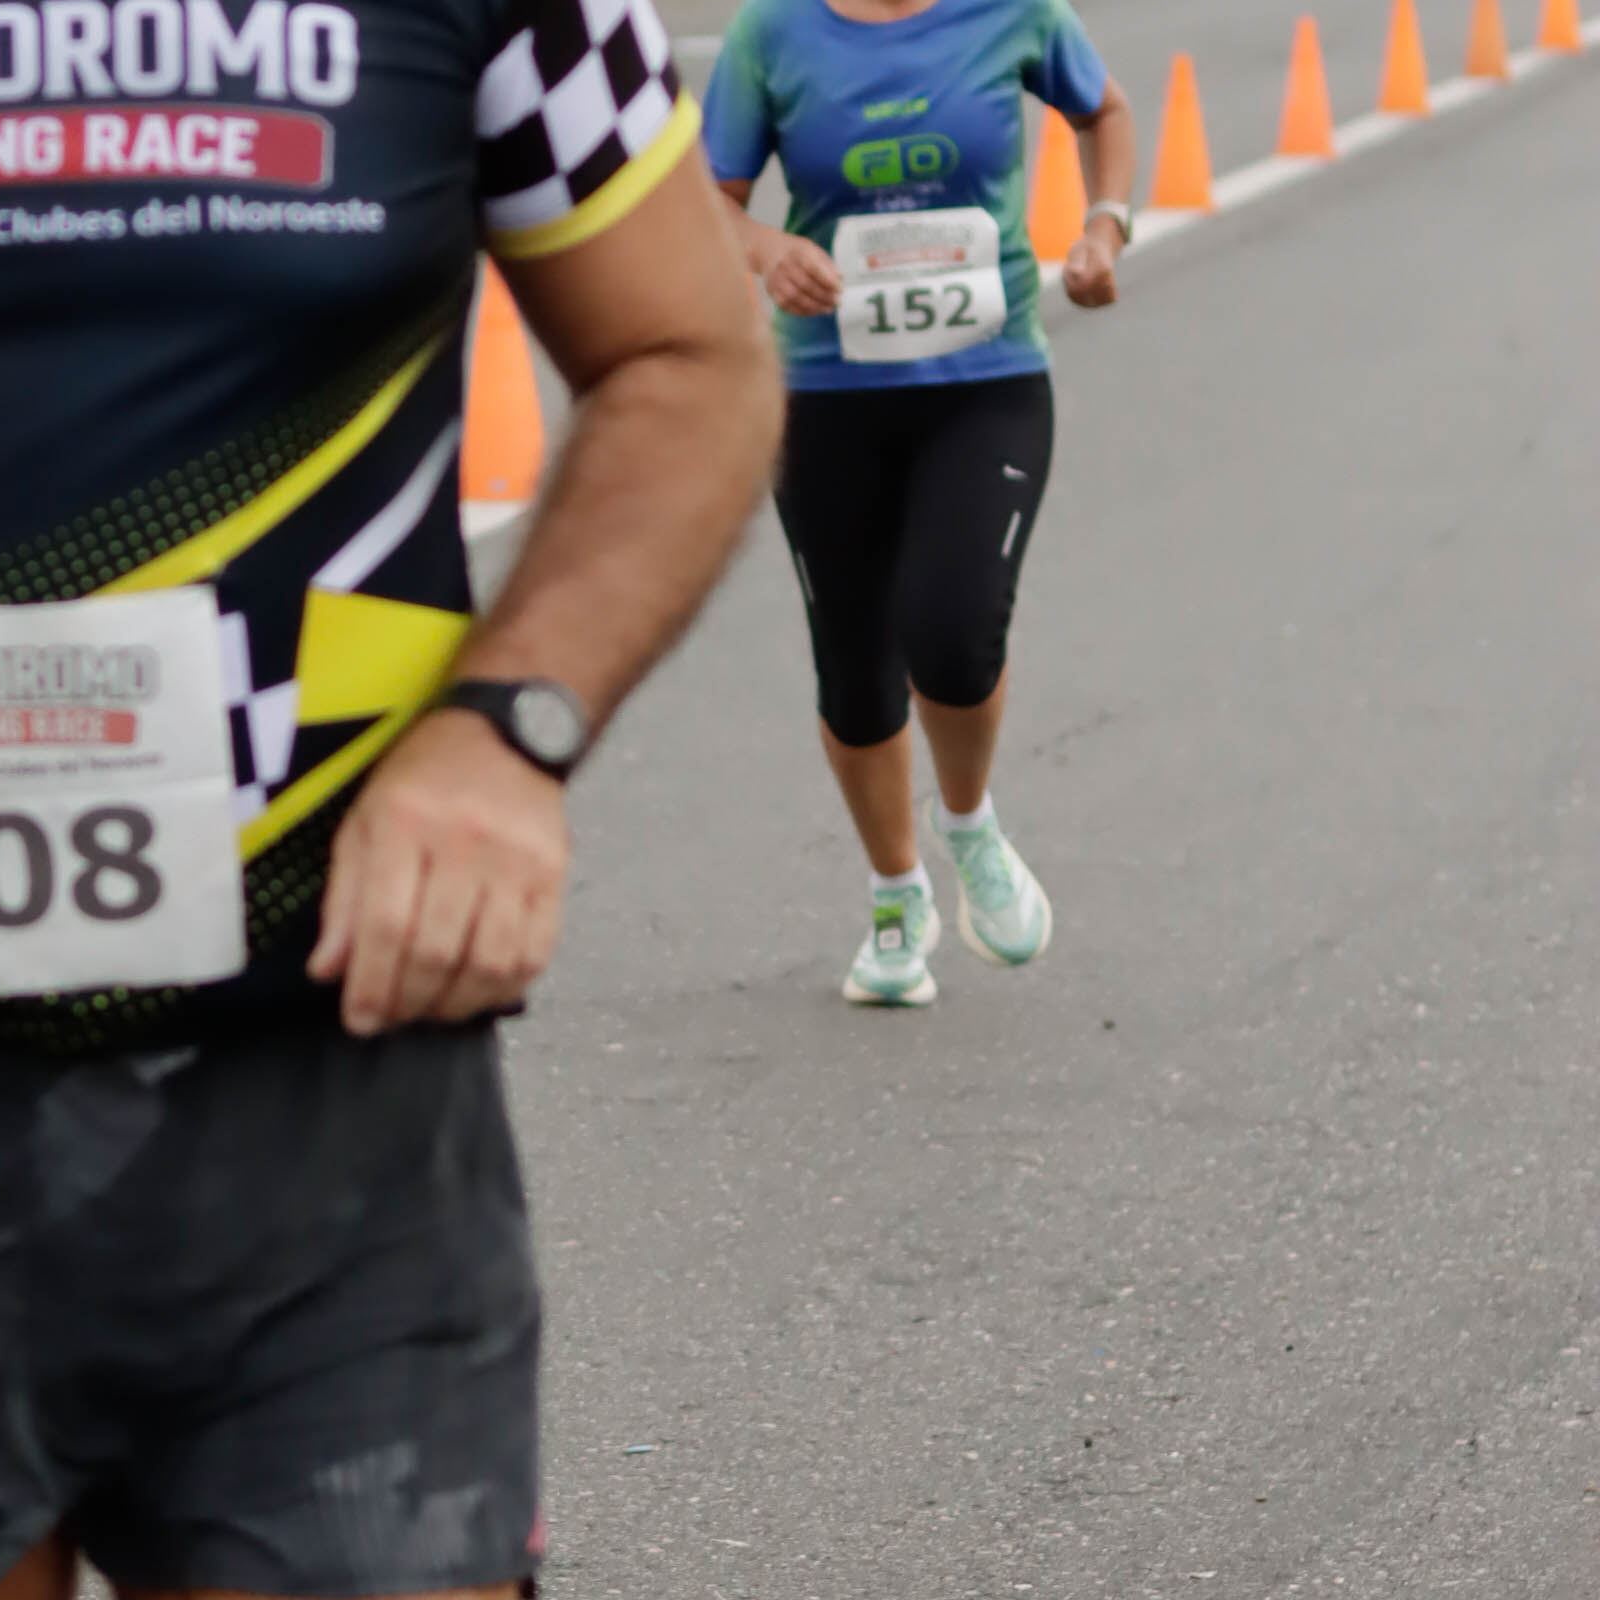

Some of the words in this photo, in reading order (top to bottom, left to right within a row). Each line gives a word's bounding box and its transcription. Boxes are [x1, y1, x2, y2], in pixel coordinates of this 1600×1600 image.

[82, 113, 261, 179] RACE
[131, 197, 202, 237] del
[208, 195, 387, 233] Noroeste
[865, 282, 978, 335] 152
